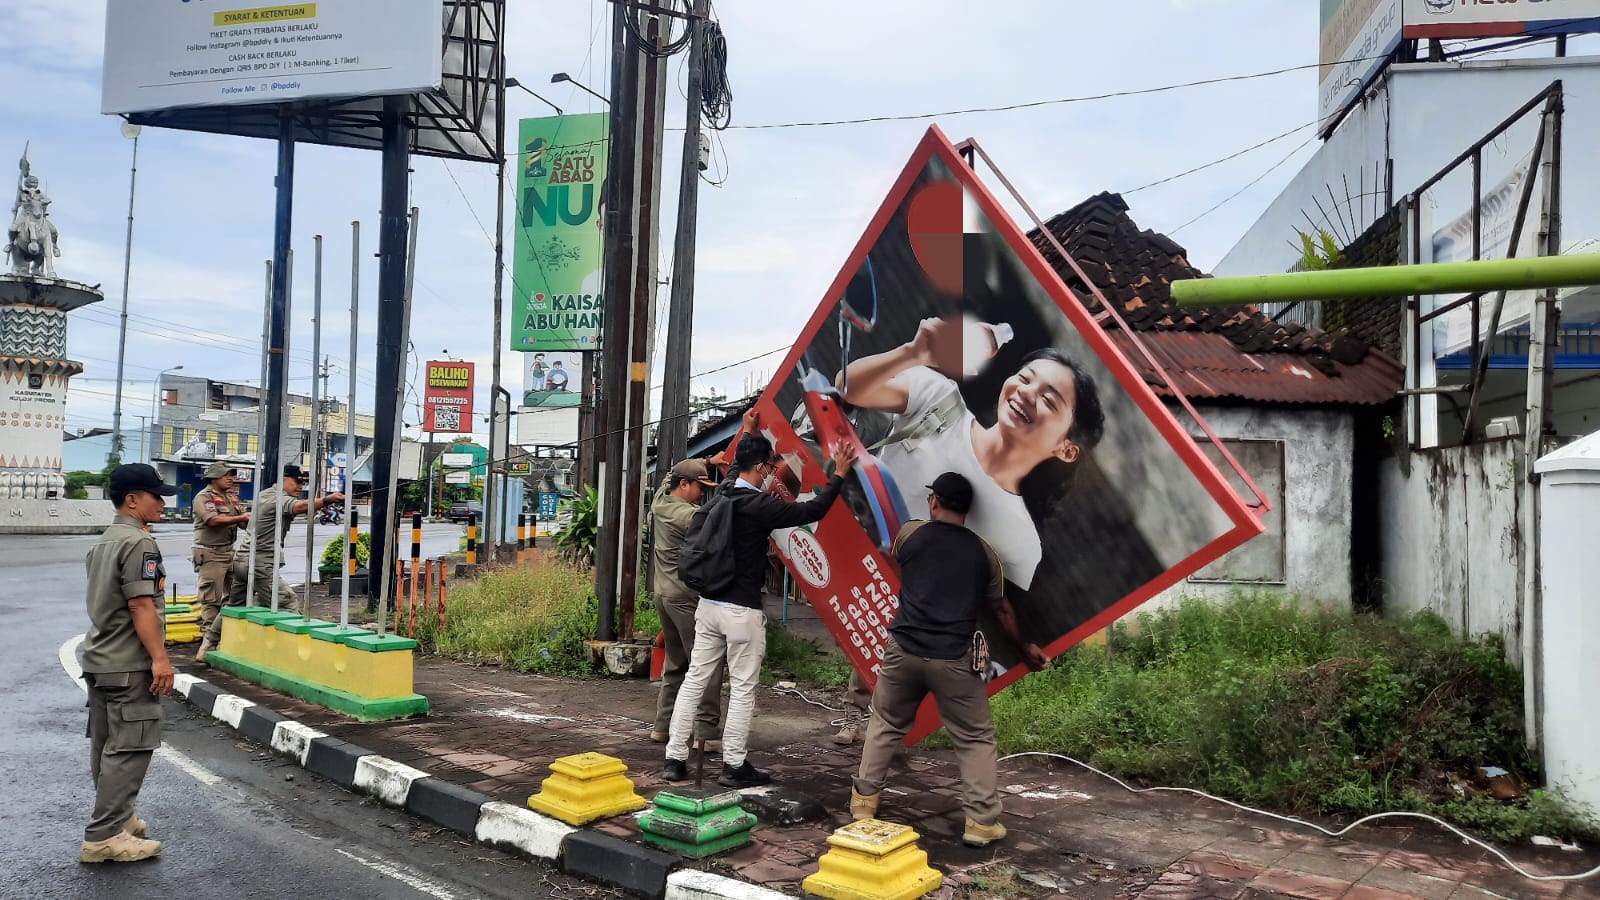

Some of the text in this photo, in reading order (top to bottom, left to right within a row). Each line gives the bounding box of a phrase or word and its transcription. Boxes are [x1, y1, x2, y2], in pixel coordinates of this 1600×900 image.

[224, 8, 305, 23] SYARAT & KETENTUAN
[210, 23, 318, 39] TIKET GRATIS TERBATAS BERLAKU
[186, 43, 207, 51] Follow
[209, 41, 241, 50] Instagram
[242, 38, 271, 48] @bpddiy
[296, 32, 342, 43] Ketentuannya
[228, 50, 297, 62] CASH BACK BERLAKU
[169, 67, 208, 78] Pembayaran
[209, 66, 235, 75] Dengan
[236, 64, 252, 72] QRIS
[221, 86, 244, 94] Follow
[553, 155, 594, 171] SATU
[548, 169, 594, 184] ABAD
[522, 184, 593, 228] NU
[524, 313, 561, 330] ABU
[429, 366, 469, 379] BALIHO
[802, 537, 823, 570] CUMA
[861, 554, 900, 610] Brea
[864, 582, 895, 624] Nik
[828, 594, 872, 660] harga
